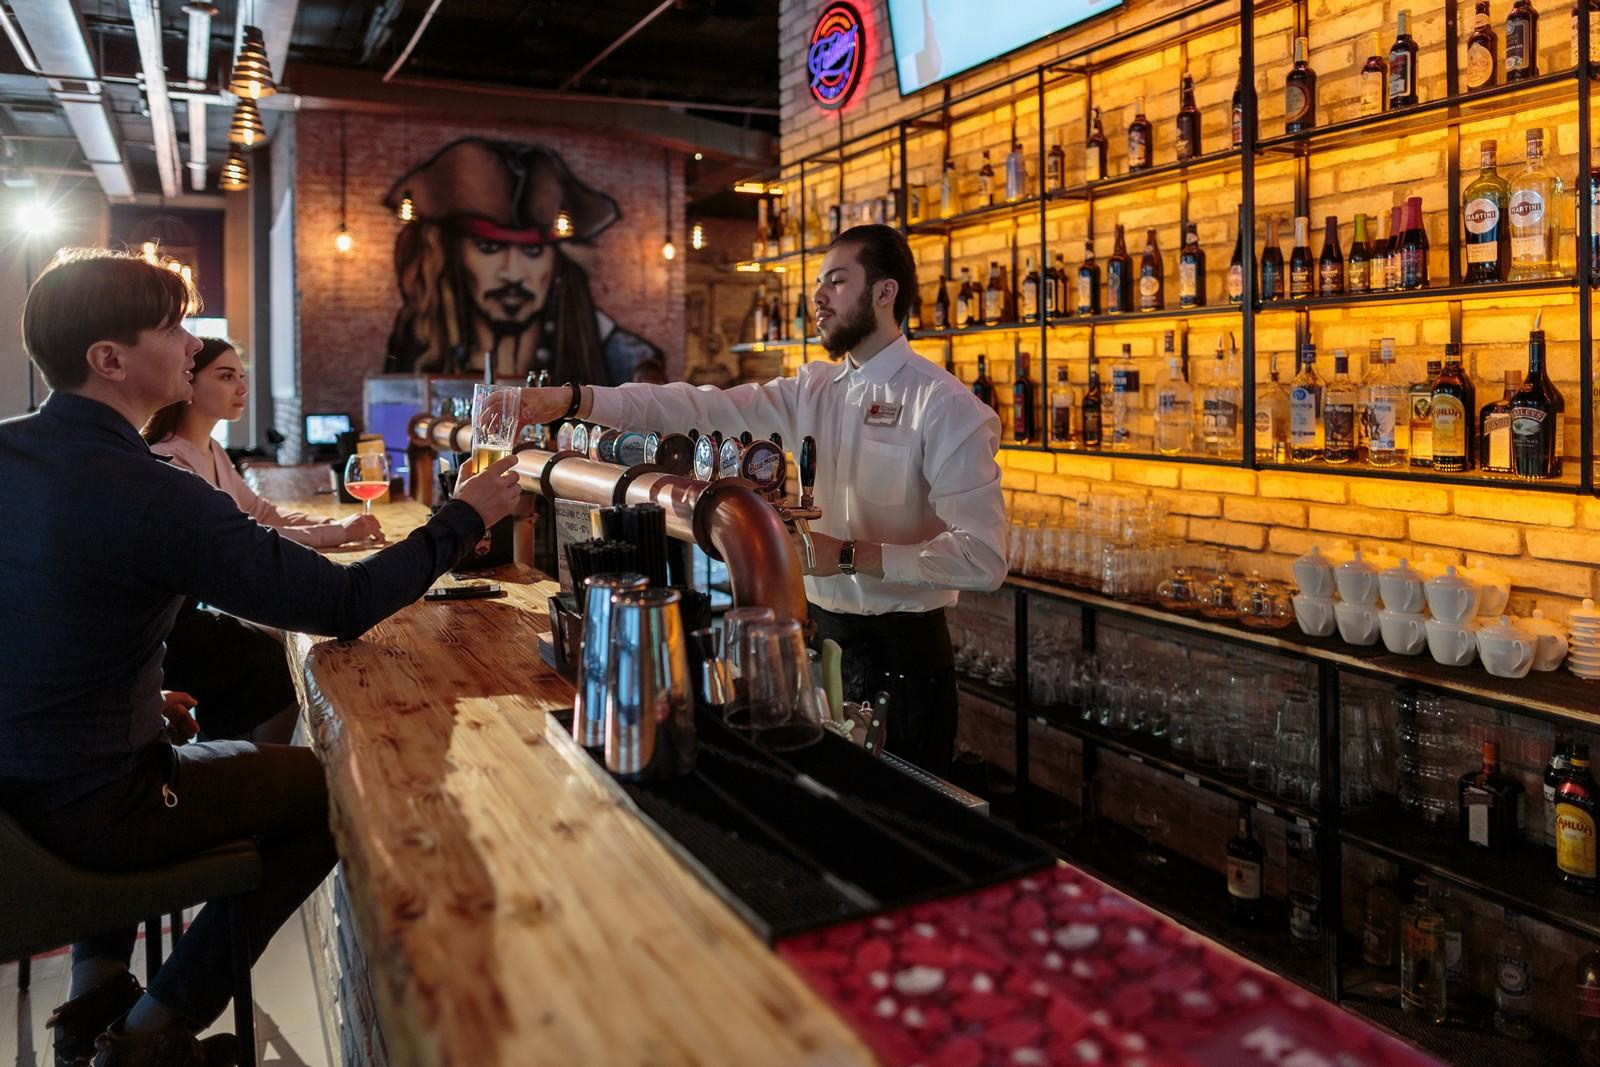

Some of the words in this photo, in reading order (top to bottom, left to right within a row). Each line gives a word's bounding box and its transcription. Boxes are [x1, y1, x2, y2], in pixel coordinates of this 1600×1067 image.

[1510, 203, 1541, 214] MARTINI
[1466, 211, 1496, 222] MARTINI
[749, 460, 764, 473] BLUE
[764, 454, 779, 467] MOON
